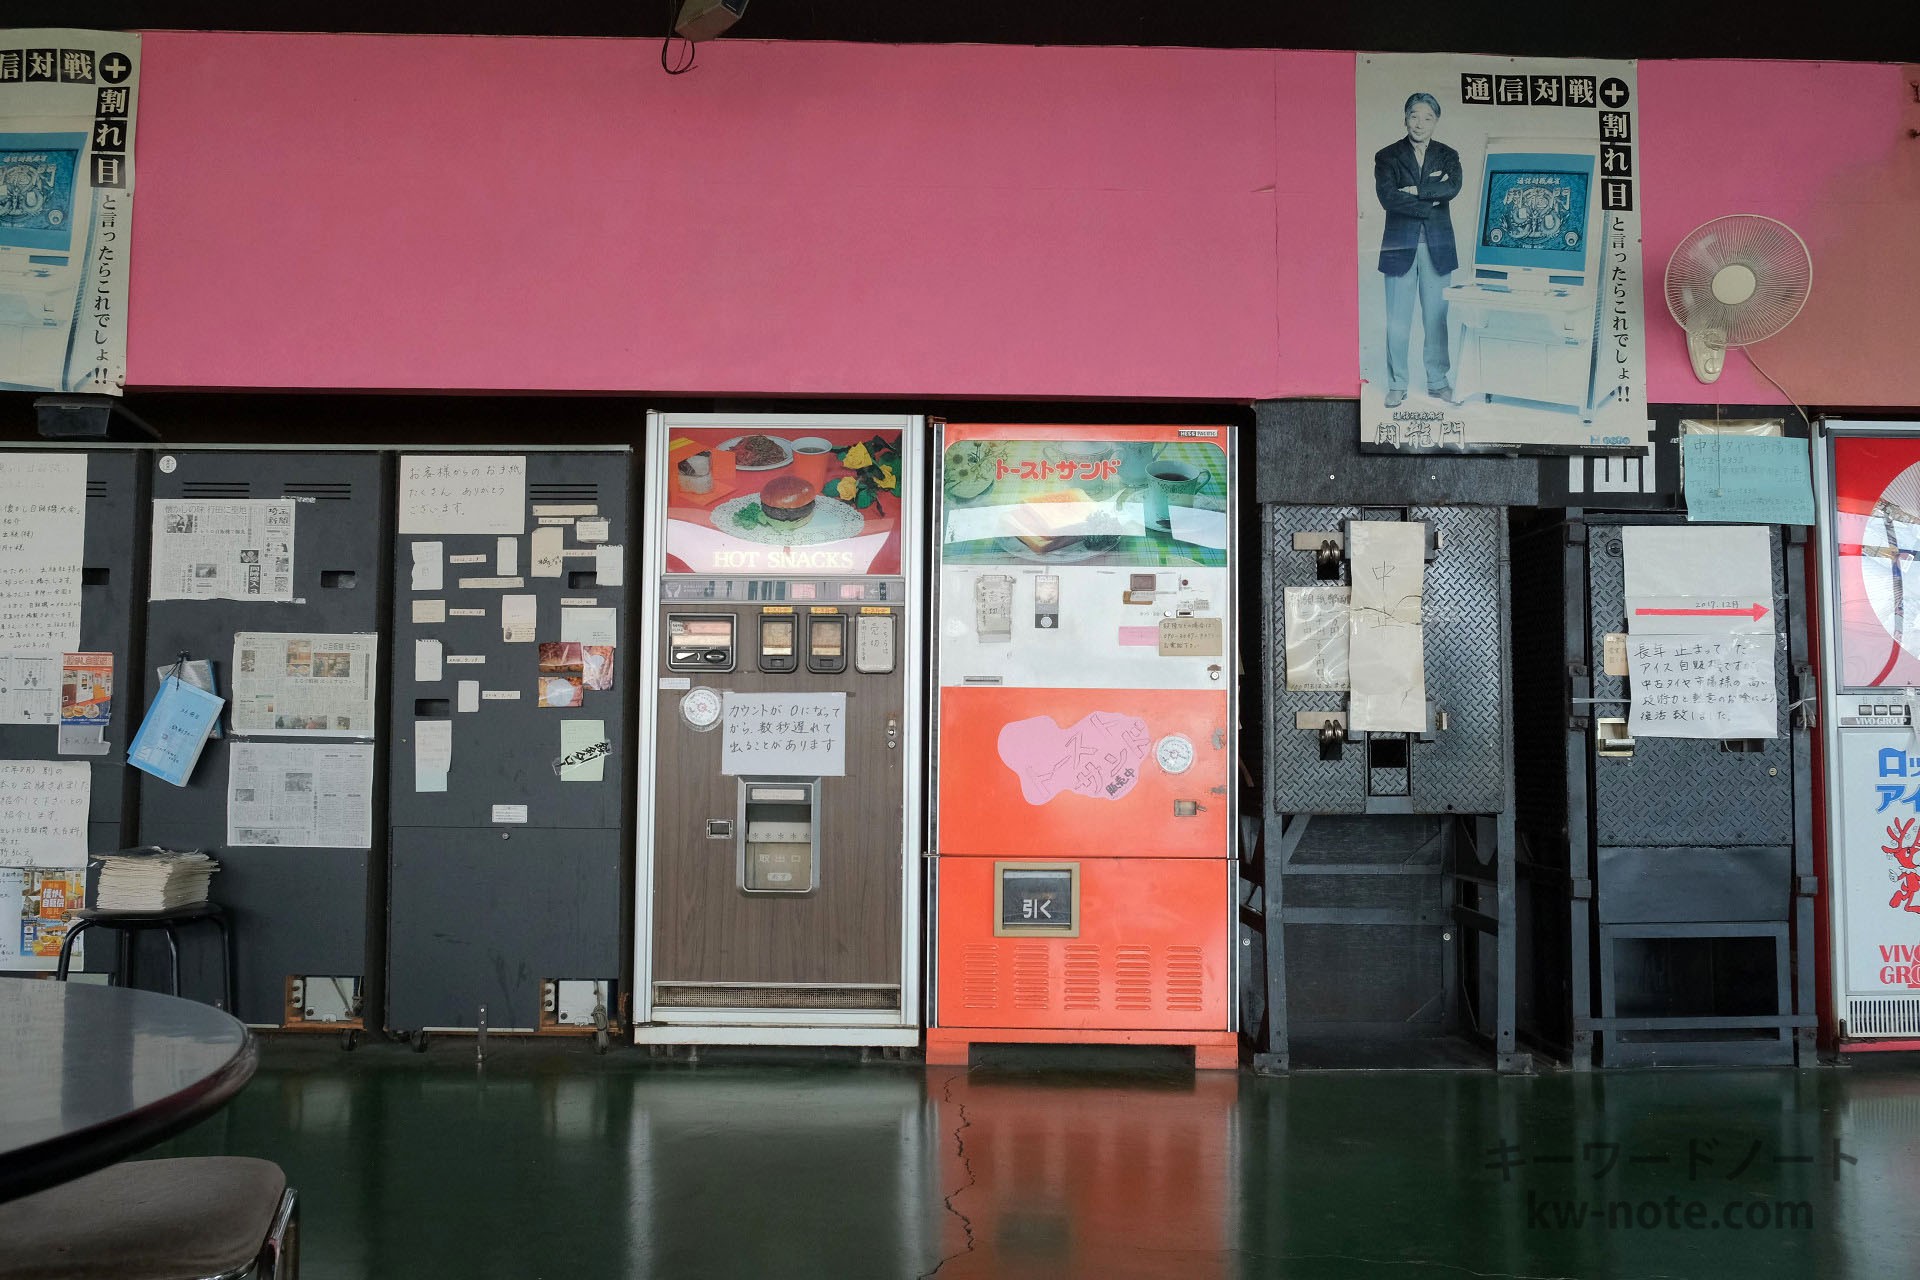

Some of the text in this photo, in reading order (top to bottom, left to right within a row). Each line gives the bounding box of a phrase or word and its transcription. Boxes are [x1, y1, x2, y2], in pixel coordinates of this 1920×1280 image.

[1462, 75, 1596, 105] 通信対戦
[94, 88, 128, 187] 割れ目
[1602, 112, 1631, 208] 割れ目
[995, 458, 1122, 482] トーストサンド
[711, 551, 855, 569] HOT SNACKS
[1855, 717, 1907, 725] VIVO GROUP
[729, 739, 836, 753] 出ることがあります
[1105, 767, 1136, 797] 販売中
[1022, 898, 1052, 919] 引く
